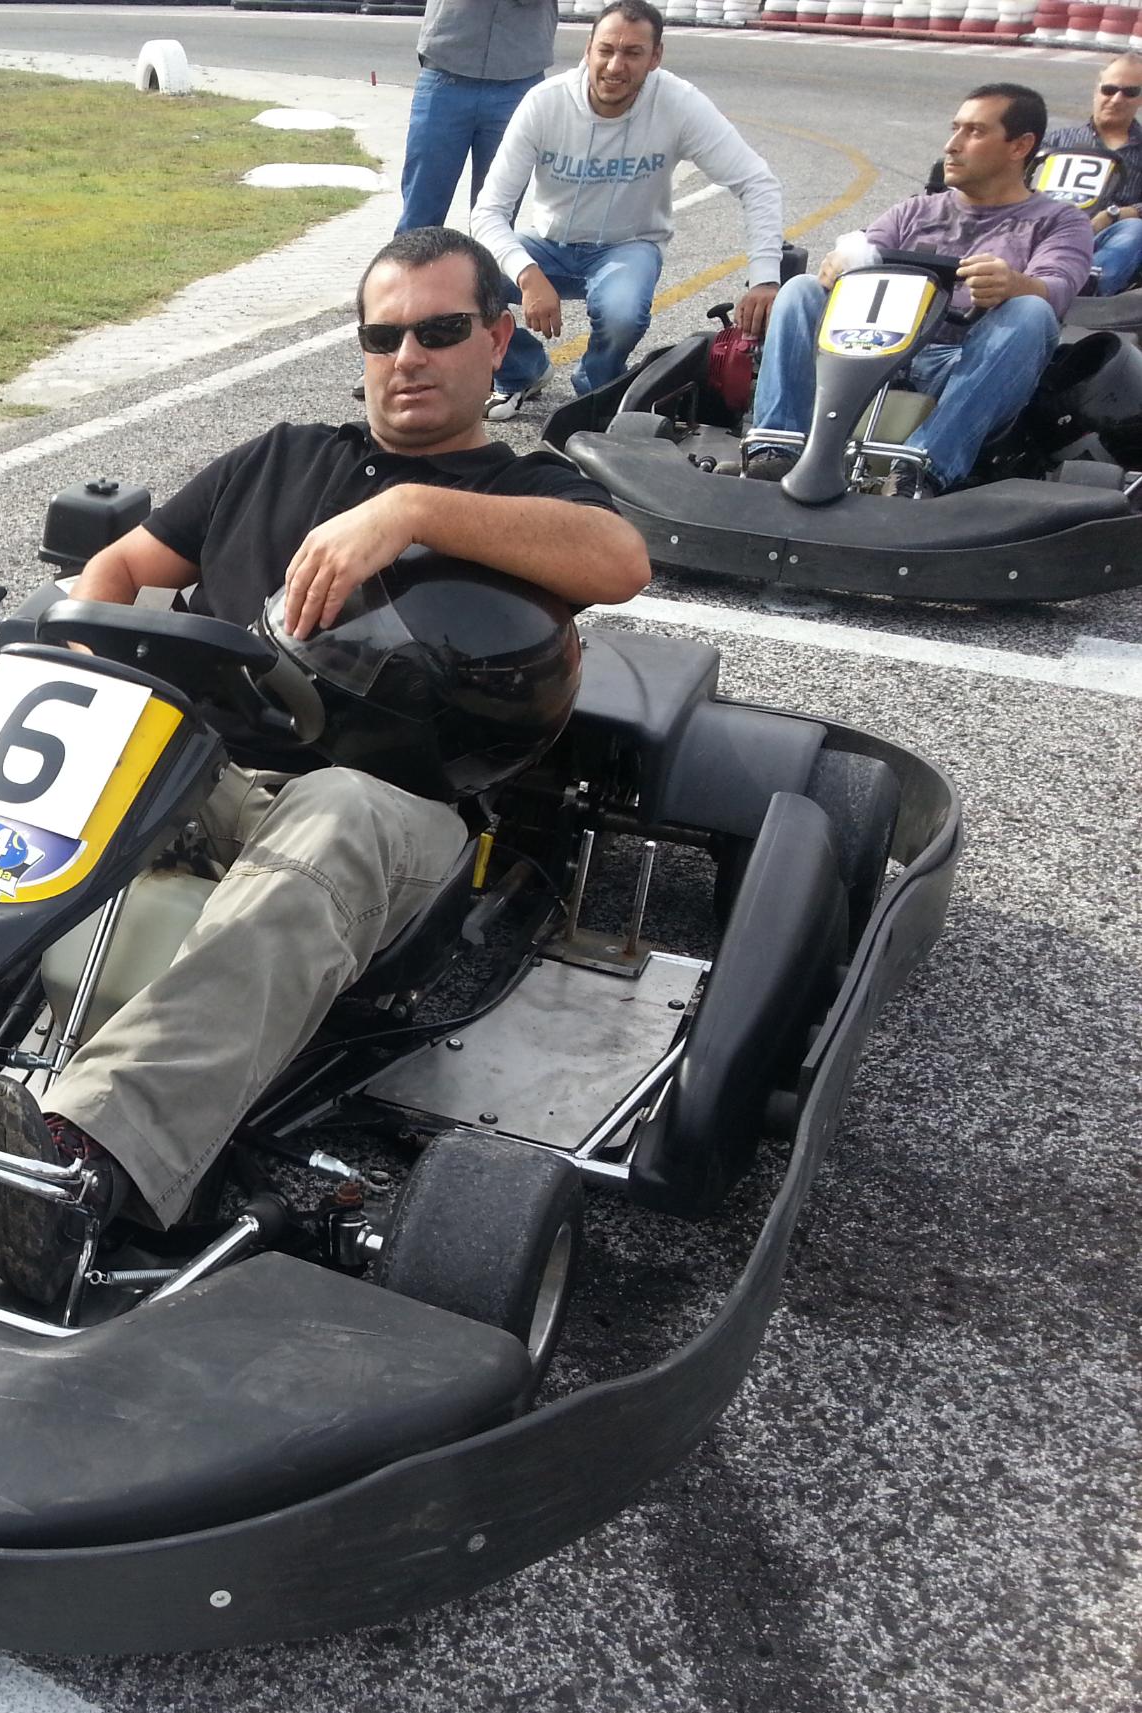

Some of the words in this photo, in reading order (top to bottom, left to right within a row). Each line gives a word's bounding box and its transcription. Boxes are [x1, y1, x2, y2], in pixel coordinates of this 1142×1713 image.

[541, 150, 665, 178] PULL&BEAR
[1058, 157, 1102, 190] 12
[866, 279, 889, 324] 1
[843, 330, 874, 343] 24
